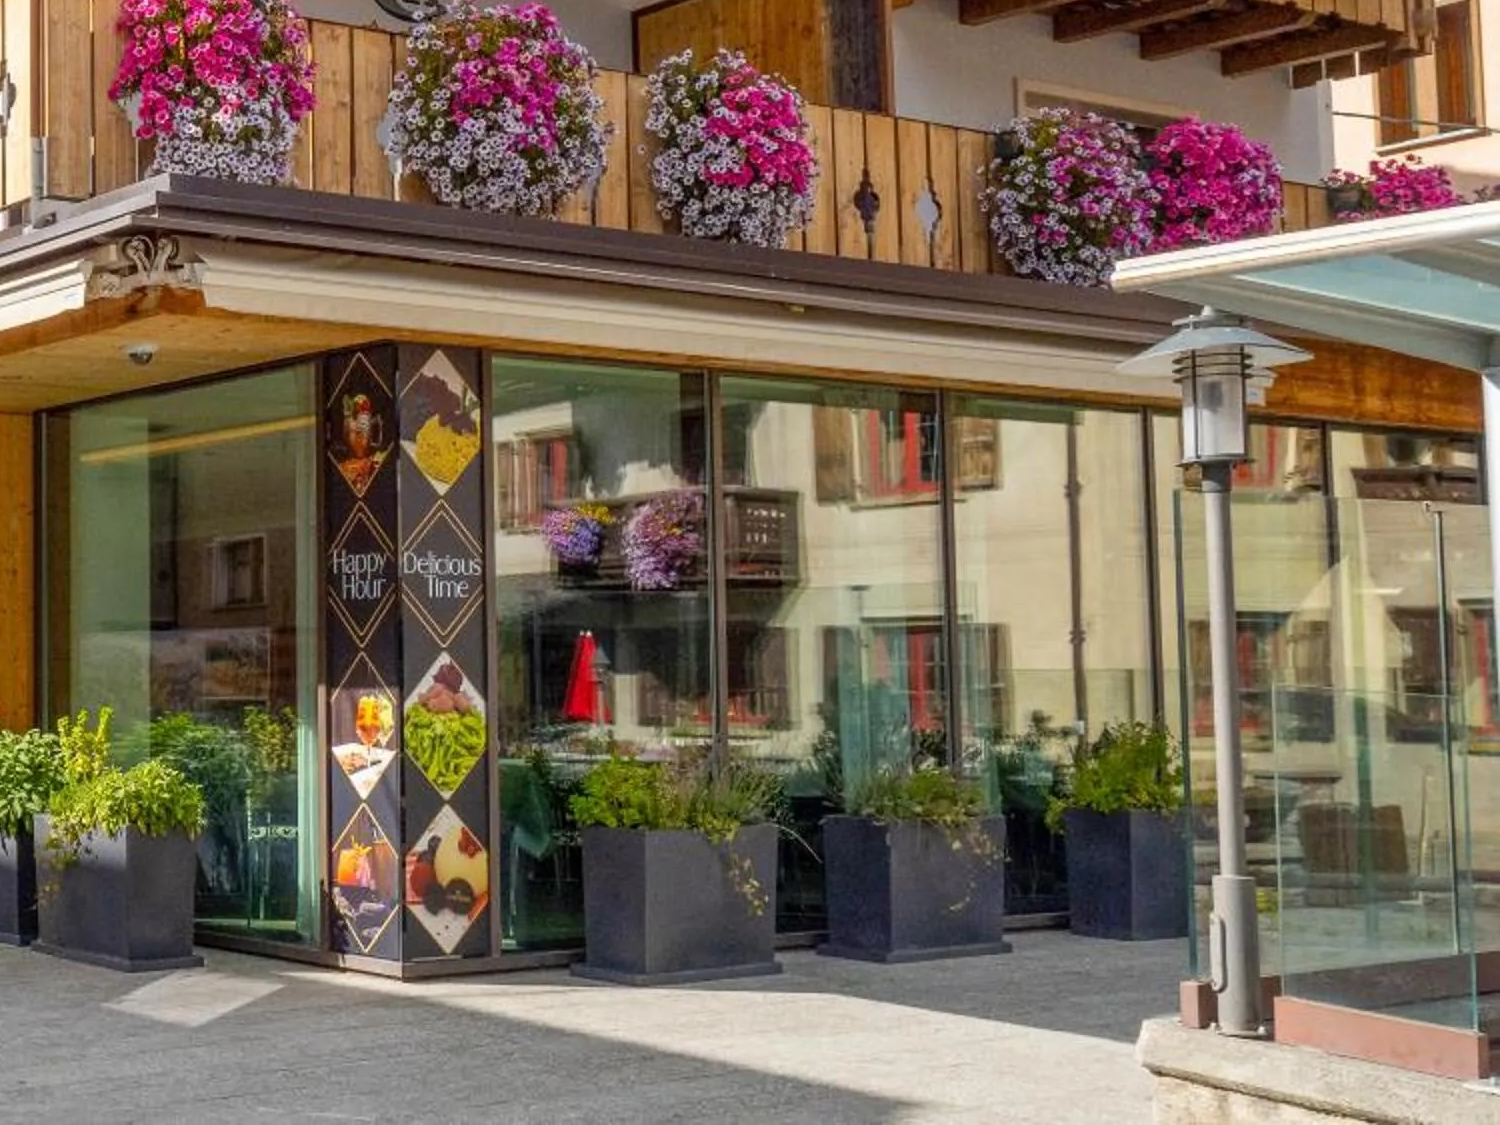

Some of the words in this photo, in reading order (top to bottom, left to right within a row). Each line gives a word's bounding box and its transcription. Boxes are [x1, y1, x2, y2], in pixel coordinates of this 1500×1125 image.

[332, 548, 387, 581] Happy
[403, 549, 482, 576] Delicious
[342, 574, 387, 600] Hour
[424, 574, 469, 599] Time
